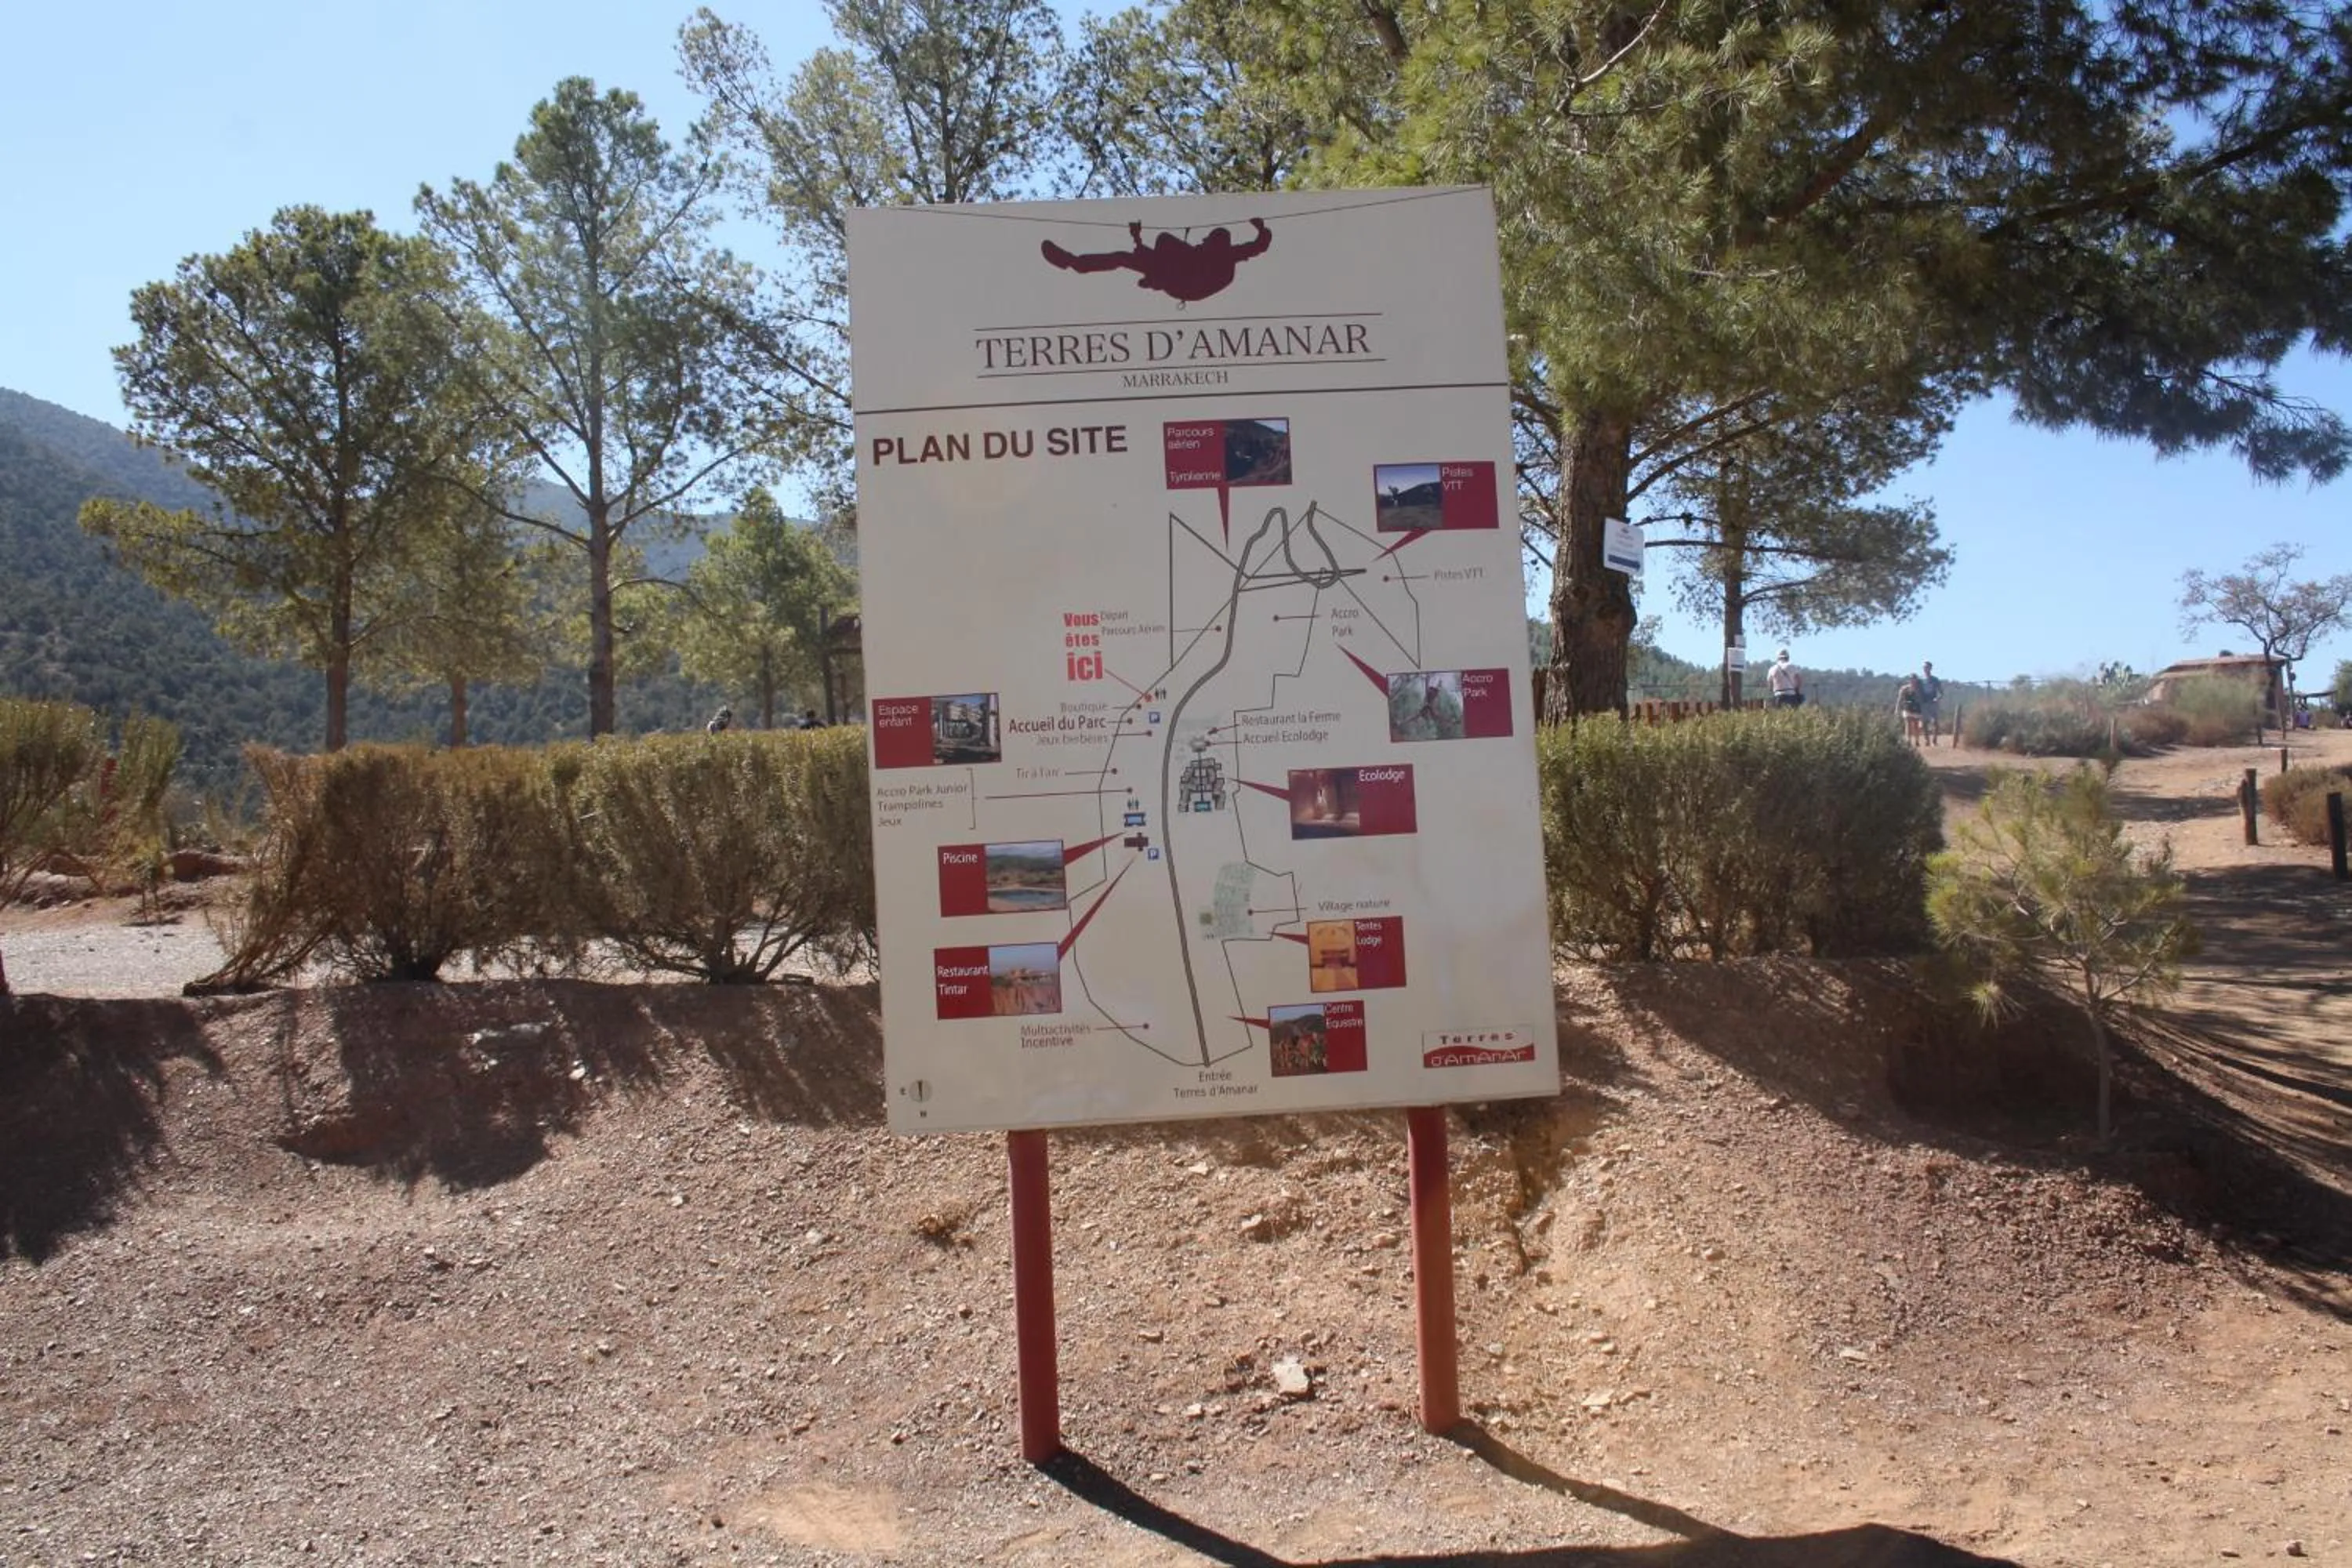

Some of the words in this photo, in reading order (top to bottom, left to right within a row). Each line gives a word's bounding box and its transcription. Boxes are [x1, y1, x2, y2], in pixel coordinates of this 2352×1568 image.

[976, 331, 1131, 369] TERRES
[1147, 323, 1372, 362] D'AMANAR
[1123, 370, 1229, 388] MARRAKECH
[1167, 427, 1214, 437] Parcours
[873, 434, 970, 466] PLAN
[983, 430, 1034, 459] DU
[1047, 425, 1127, 456] SITE
[1442, 466, 1473, 477] Pistes
[1443, 481, 1464, 491] VTT
[1064, 612, 1100, 627] Vous
[1065, 633, 1100, 648] êtes
[1066, 651, 1103, 681] ici
[1462, 673, 1494, 682] Accro
[1463, 687, 1488, 698] Park
[878, 704, 919, 717] Espace
[1009, 716, 1054, 733] Accueil
[1058, 715, 1075, 730] du
[1078, 714, 1107, 729] Parc
[1242, 713, 1294, 726] Restaurant
[1298, 712, 1307, 723] la
[1308, 711, 1341, 723] Ferme
[1243, 731, 1279, 744] Accueil
[1282, 729, 1329, 742] Ecolodge
[1359, 768, 1405, 782] Ecolodge
[878, 800, 944, 812] Trampolines
[943, 852, 978, 865] Piscine
[1318, 901, 1354, 912] Village
[938, 965, 989, 978] Restaurant
[938, 984, 968, 996] Tintar
[1021, 1036, 1073, 1049] Incentive
[1439, 1032, 1515, 1045] Terres
[1198, 1070, 1232, 1083] Entrée
[1174, 1087, 1207, 1099] Terres
